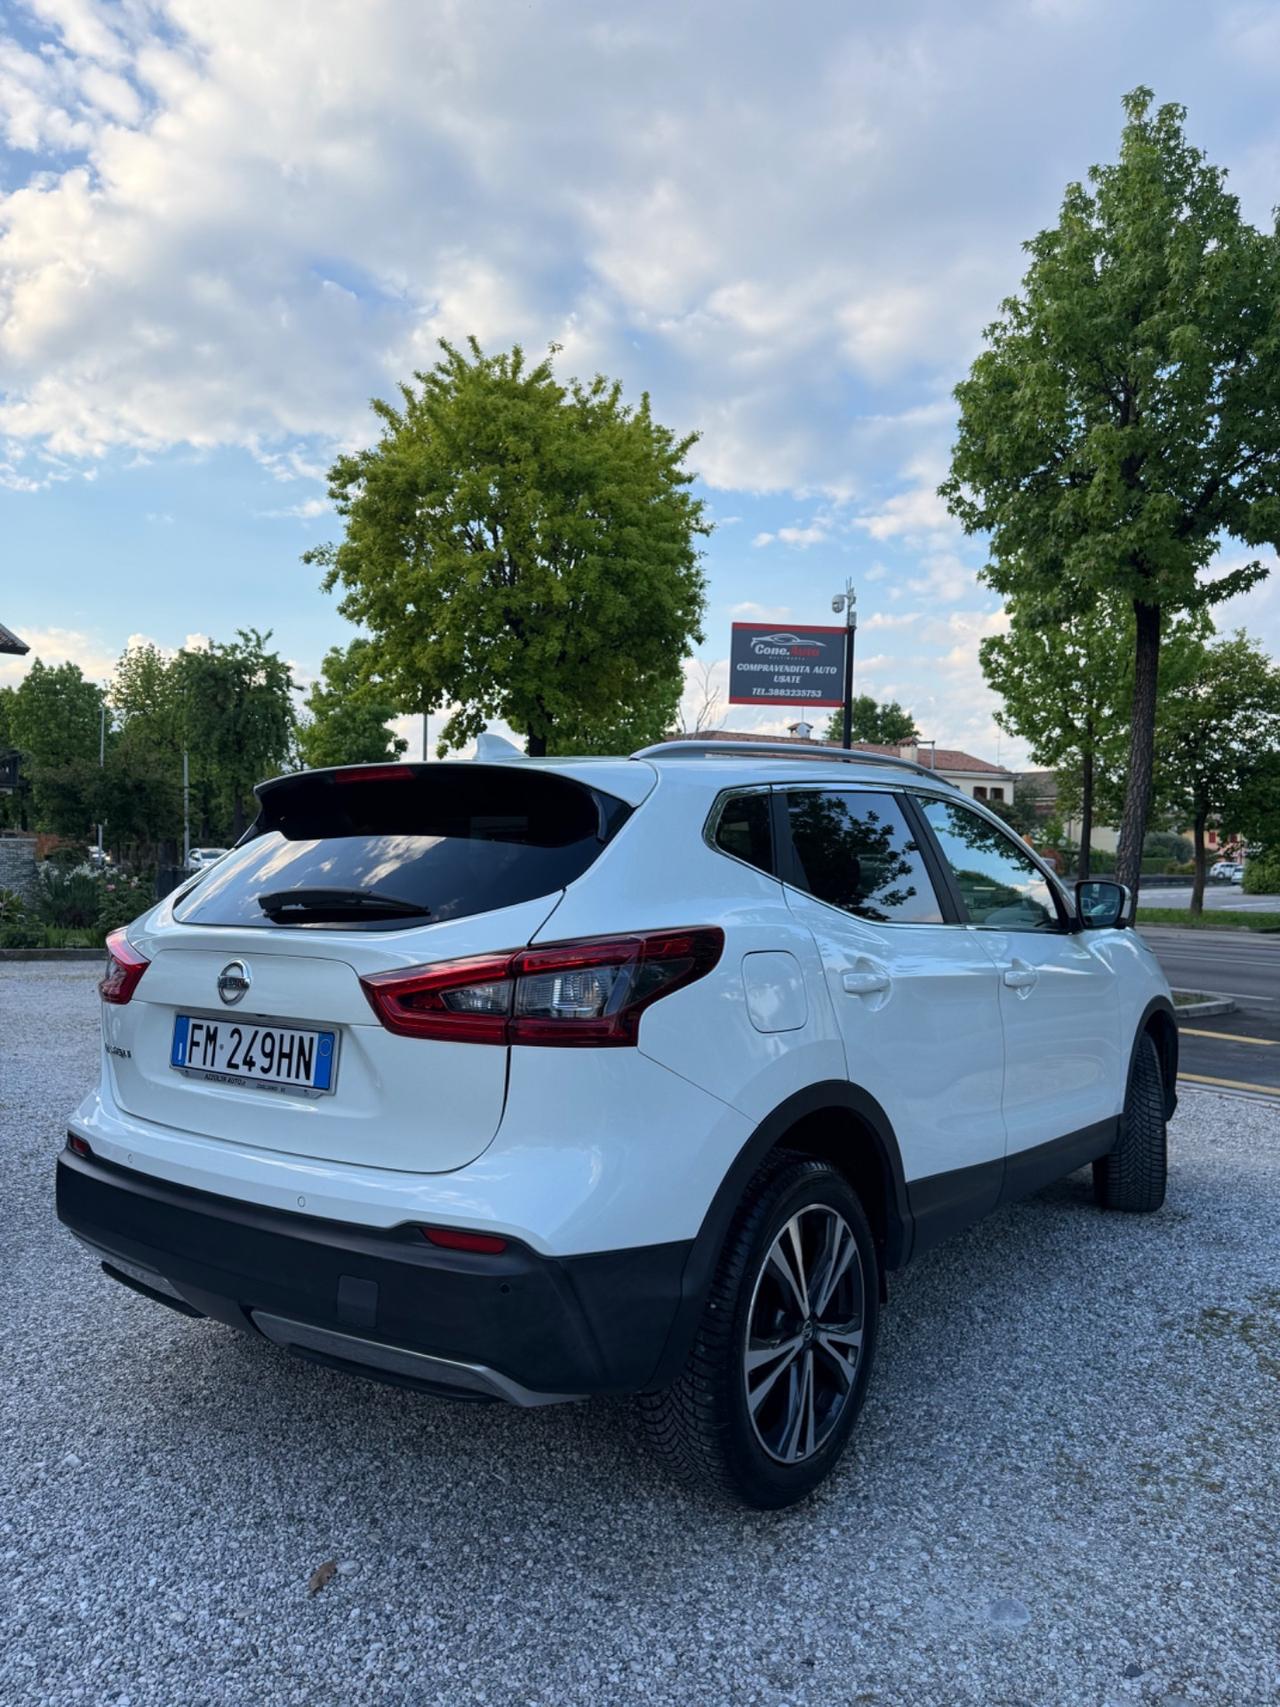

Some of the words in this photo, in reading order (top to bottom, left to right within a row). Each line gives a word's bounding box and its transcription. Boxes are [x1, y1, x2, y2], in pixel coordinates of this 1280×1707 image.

[736, 663, 810, 674] COMPRAVENDITA
[812, 666, 837, 674] AUTO
[773, 675, 802, 684] USATE
[187, 1023, 218, 1067] FM
[226, 1027, 314, 1081] 249HN
